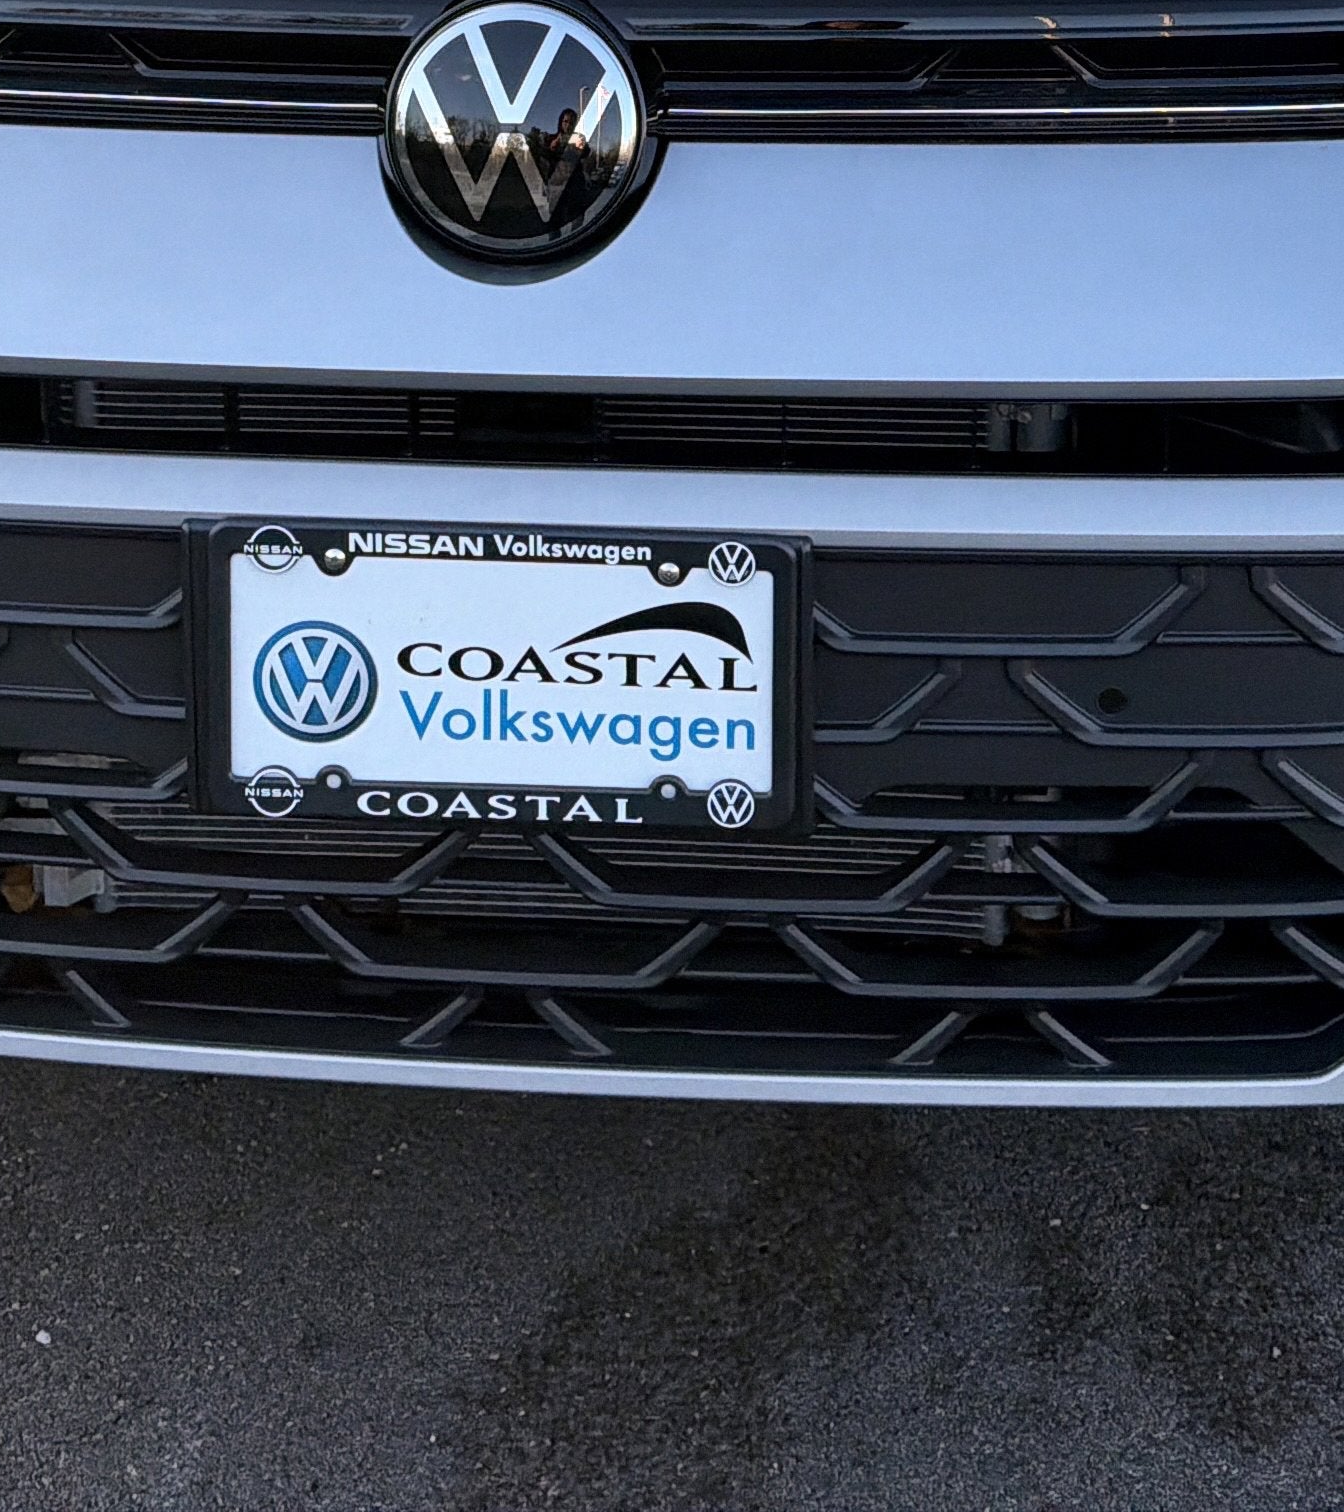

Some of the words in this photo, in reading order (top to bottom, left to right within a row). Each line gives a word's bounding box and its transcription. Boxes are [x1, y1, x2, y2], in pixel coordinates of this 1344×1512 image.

[243, 542, 303, 554] NISSAN
[348, 532, 484, 557] NISSAN
[493, 534, 652, 565] Volkswagen
[397, 642, 758, 691] COASTAL
[399, 688, 755, 761] Volkswagen
[244, 787, 304, 798] NISSAN
[357, 791, 643, 823] COASTAL
